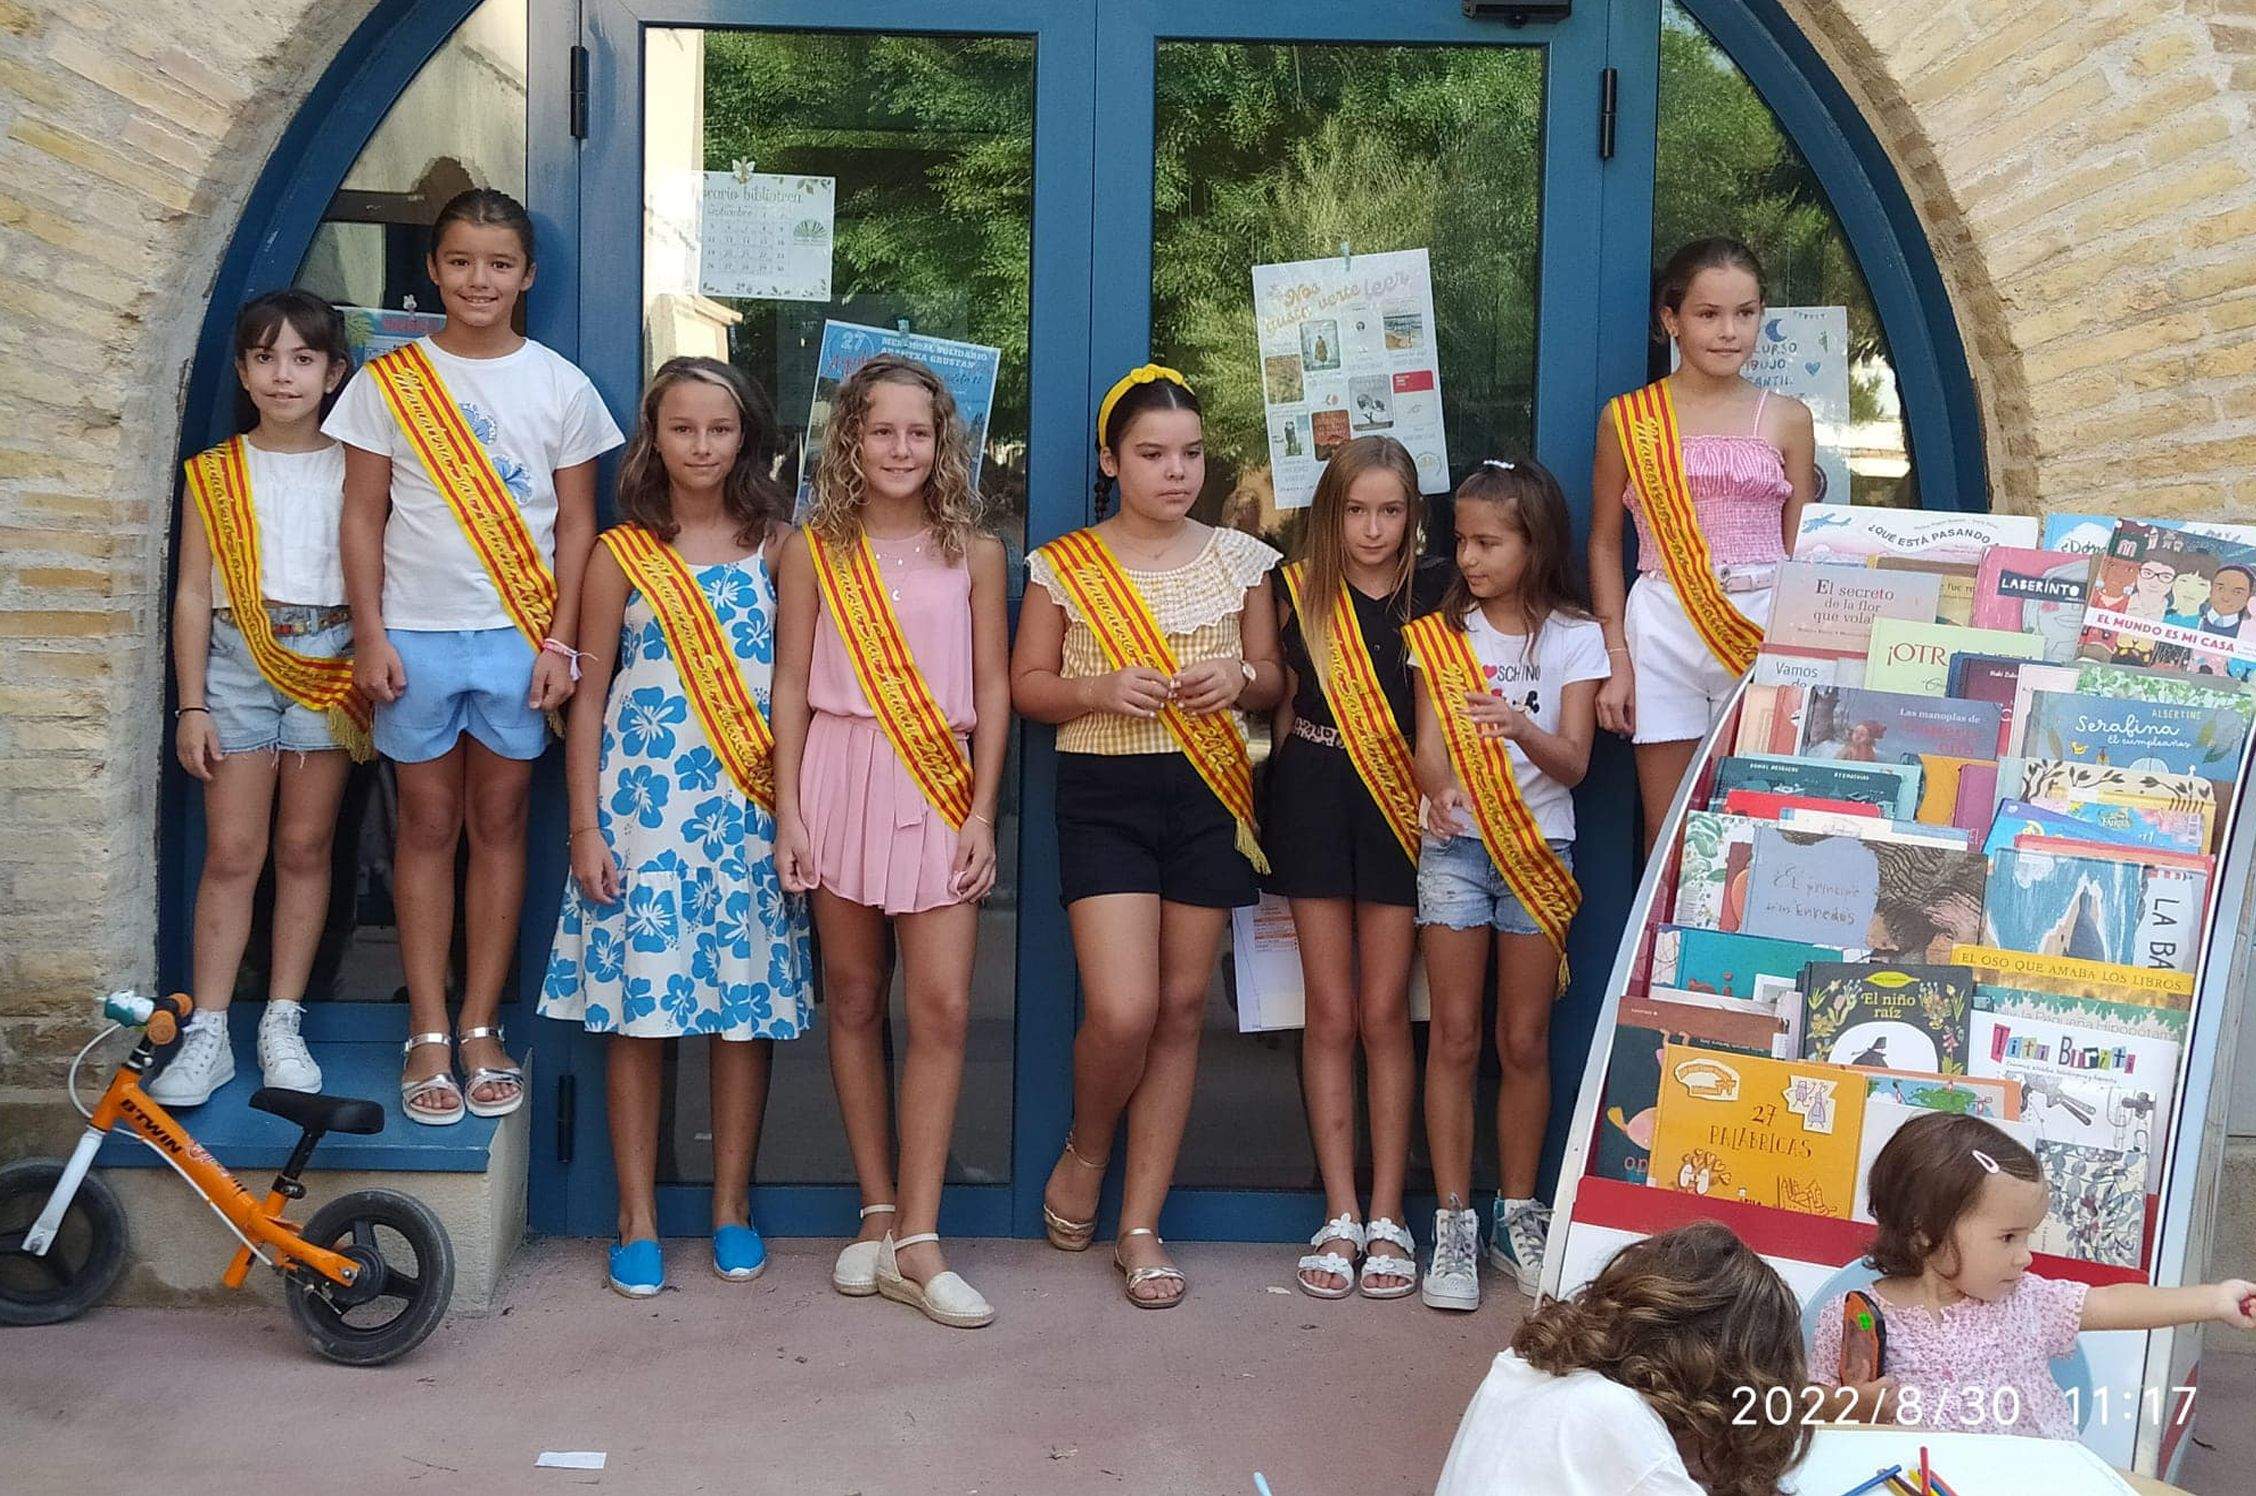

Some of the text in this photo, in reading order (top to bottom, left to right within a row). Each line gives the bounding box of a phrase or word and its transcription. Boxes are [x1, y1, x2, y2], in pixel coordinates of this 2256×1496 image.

[1898, 537, 1930, 548] ESTÁ
[1932, 528, 1991, 545] PASANDO
[1816, 579, 1895, 601] El secreto
[511, 578, 552, 630] 2022
[1825, 600, 1881, 613] de la flor
[1813, 611, 1840, 625] que
[2096, 614, 2110, 625] EL
[2113, 617, 2163, 637] MUNDO
[2165, 629, 2179, 640] ES
[2181, 631, 2198, 645] MI
[2200, 636, 2236, 653] CASA
[1887, 643, 1949, 667] ¡OTR
[1775, 661, 1819, 678] Vamos
[1899, 708, 1918, 718] Las
[1968, 714, 1982, 724] de
[2075, 714, 2180, 737] Serafina
[1193, 725, 1237, 773] 2022
[913, 741, 958, 790] 2022
[1532, 879, 1573, 927] 2022
[2148, 899, 2180, 970] LA BA
[1961, 953, 1977, 964] EL
[1980, 954, 2009, 968] OSO
[2014, 960, 2044, 973] QUE
[2049, 966, 2096, 980] AMABA
[2103, 972, 2127, 984] LOS
[1862, 992, 1916, 1006] El niño
[1874, 1006, 1902, 1019] raíz
[1752, 1104, 1777, 1127] 27
[1710, 1125, 1812, 1158] PALABRICAS
